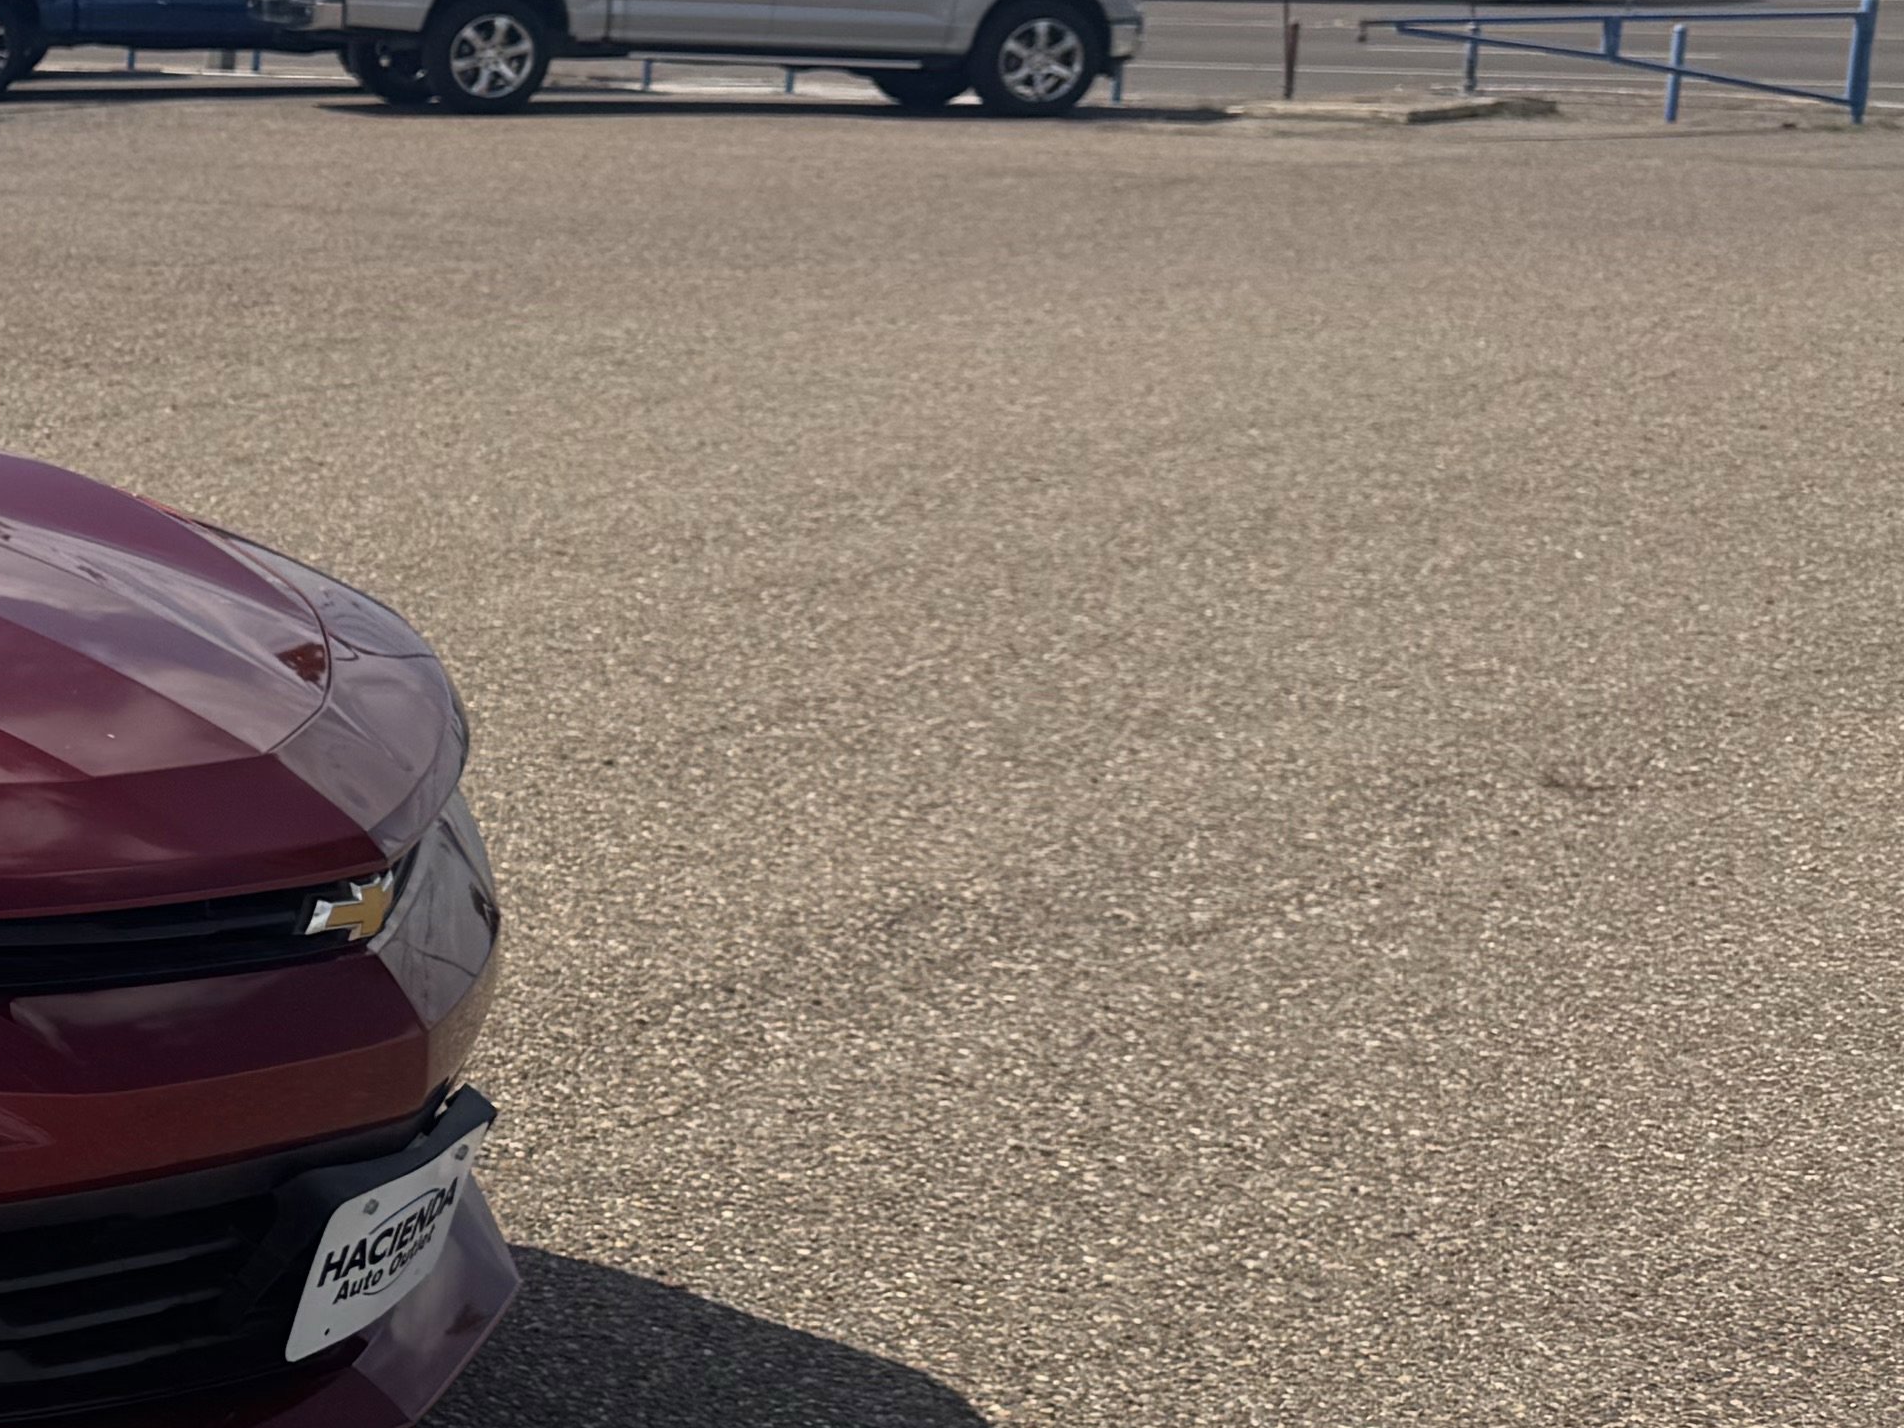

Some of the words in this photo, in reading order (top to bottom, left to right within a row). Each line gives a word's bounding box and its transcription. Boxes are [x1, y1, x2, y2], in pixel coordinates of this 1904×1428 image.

[317, 1177, 458, 1287] HACIENDA
[333, 1266, 383, 1304] Auto
[388, 1223, 436, 1276] Outlet
